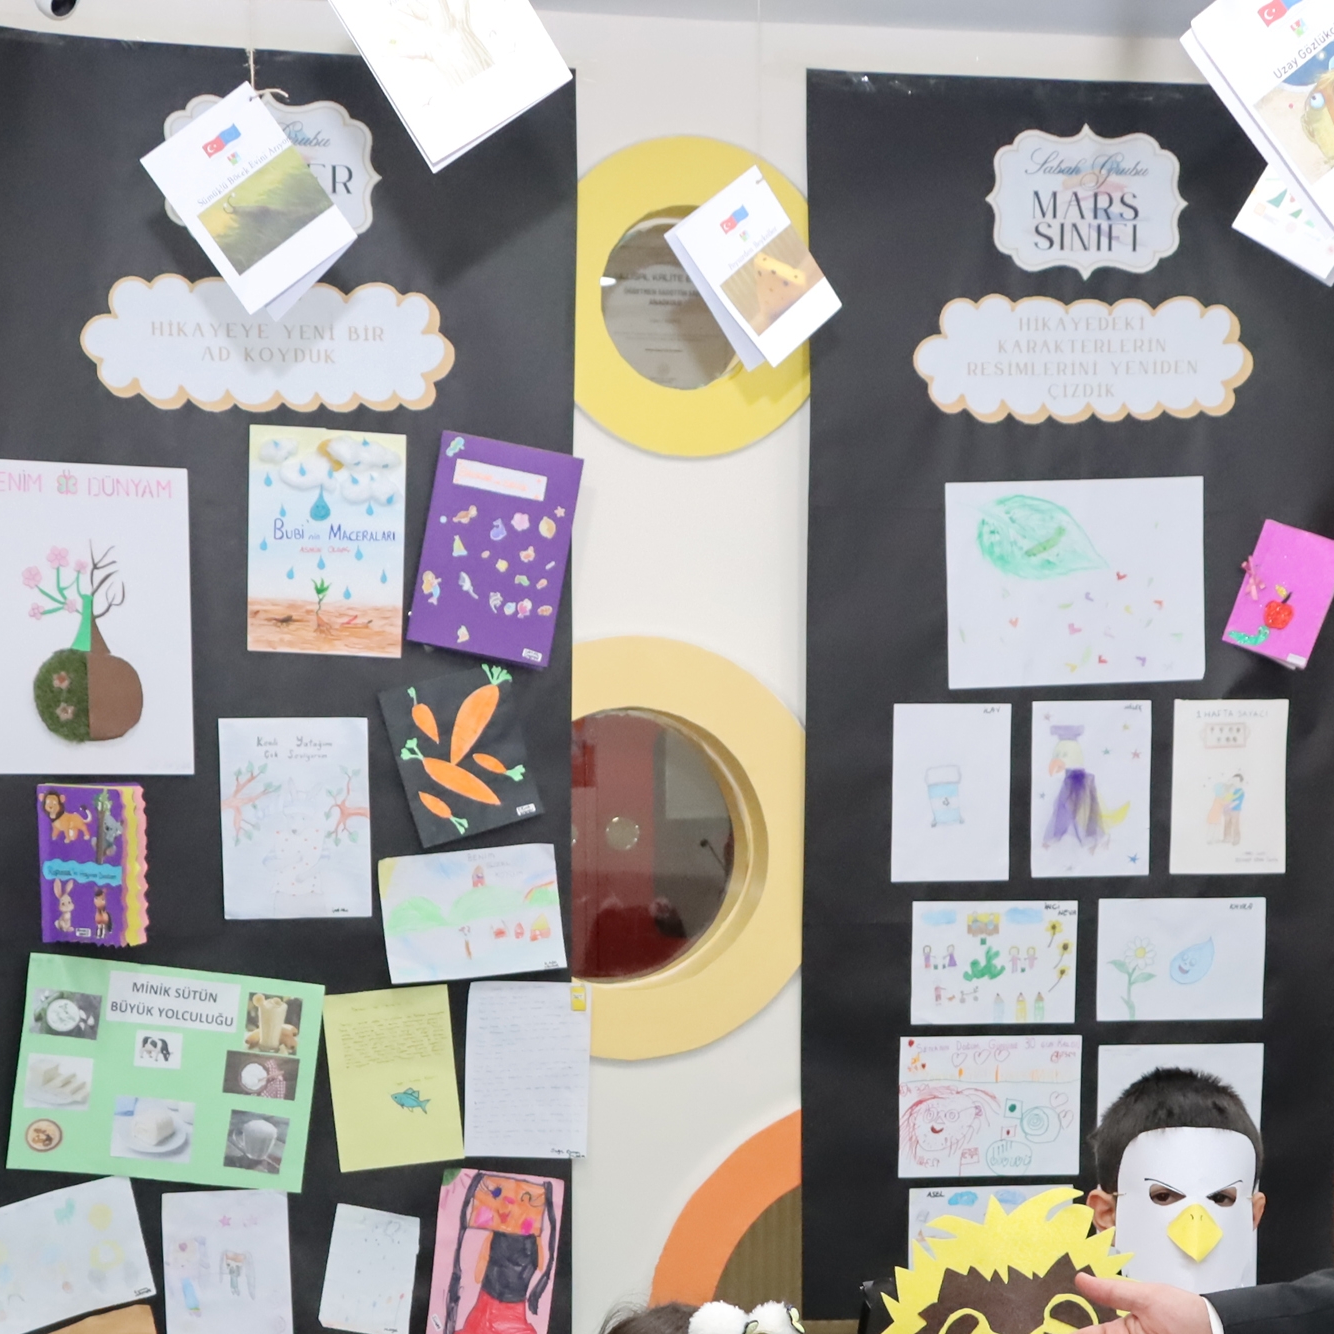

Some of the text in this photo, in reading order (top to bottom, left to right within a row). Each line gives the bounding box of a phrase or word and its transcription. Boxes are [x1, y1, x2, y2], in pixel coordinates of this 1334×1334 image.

[1273, 59, 1299, 79] Uzay
[197, 181, 229, 206] Sümüklü
[227, 166, 250, 185] Böcek
[248, 152, 268, 171] Evini
[1025, 148, 1149, 191] Sabah Grubu
[1032, 190, 1139, 221] MARS
[1034, 222, 1138, 252] SINIFI
[151, 320, 384, 342] HİKAYEYE YENİ BİR
[1019, 315, 1145, 332] HİKAYEDEKİ
[202, 346, 336, 364] AD KOYDUK
[998, 338, 1166, 353] KARAKTERLERİN
[967, 360, 1198, 376] RESİMLERİNİ YENİDEN
[1048, 382, 1115, 400] ÇİZDİK
[88, 475, 172, 498] DÜNYAM
[132, 981, 218, 1003] MİNİK SÜTÜN
[110, 1000, 234, 1027] BÜYÜK YOLCULUĞU
